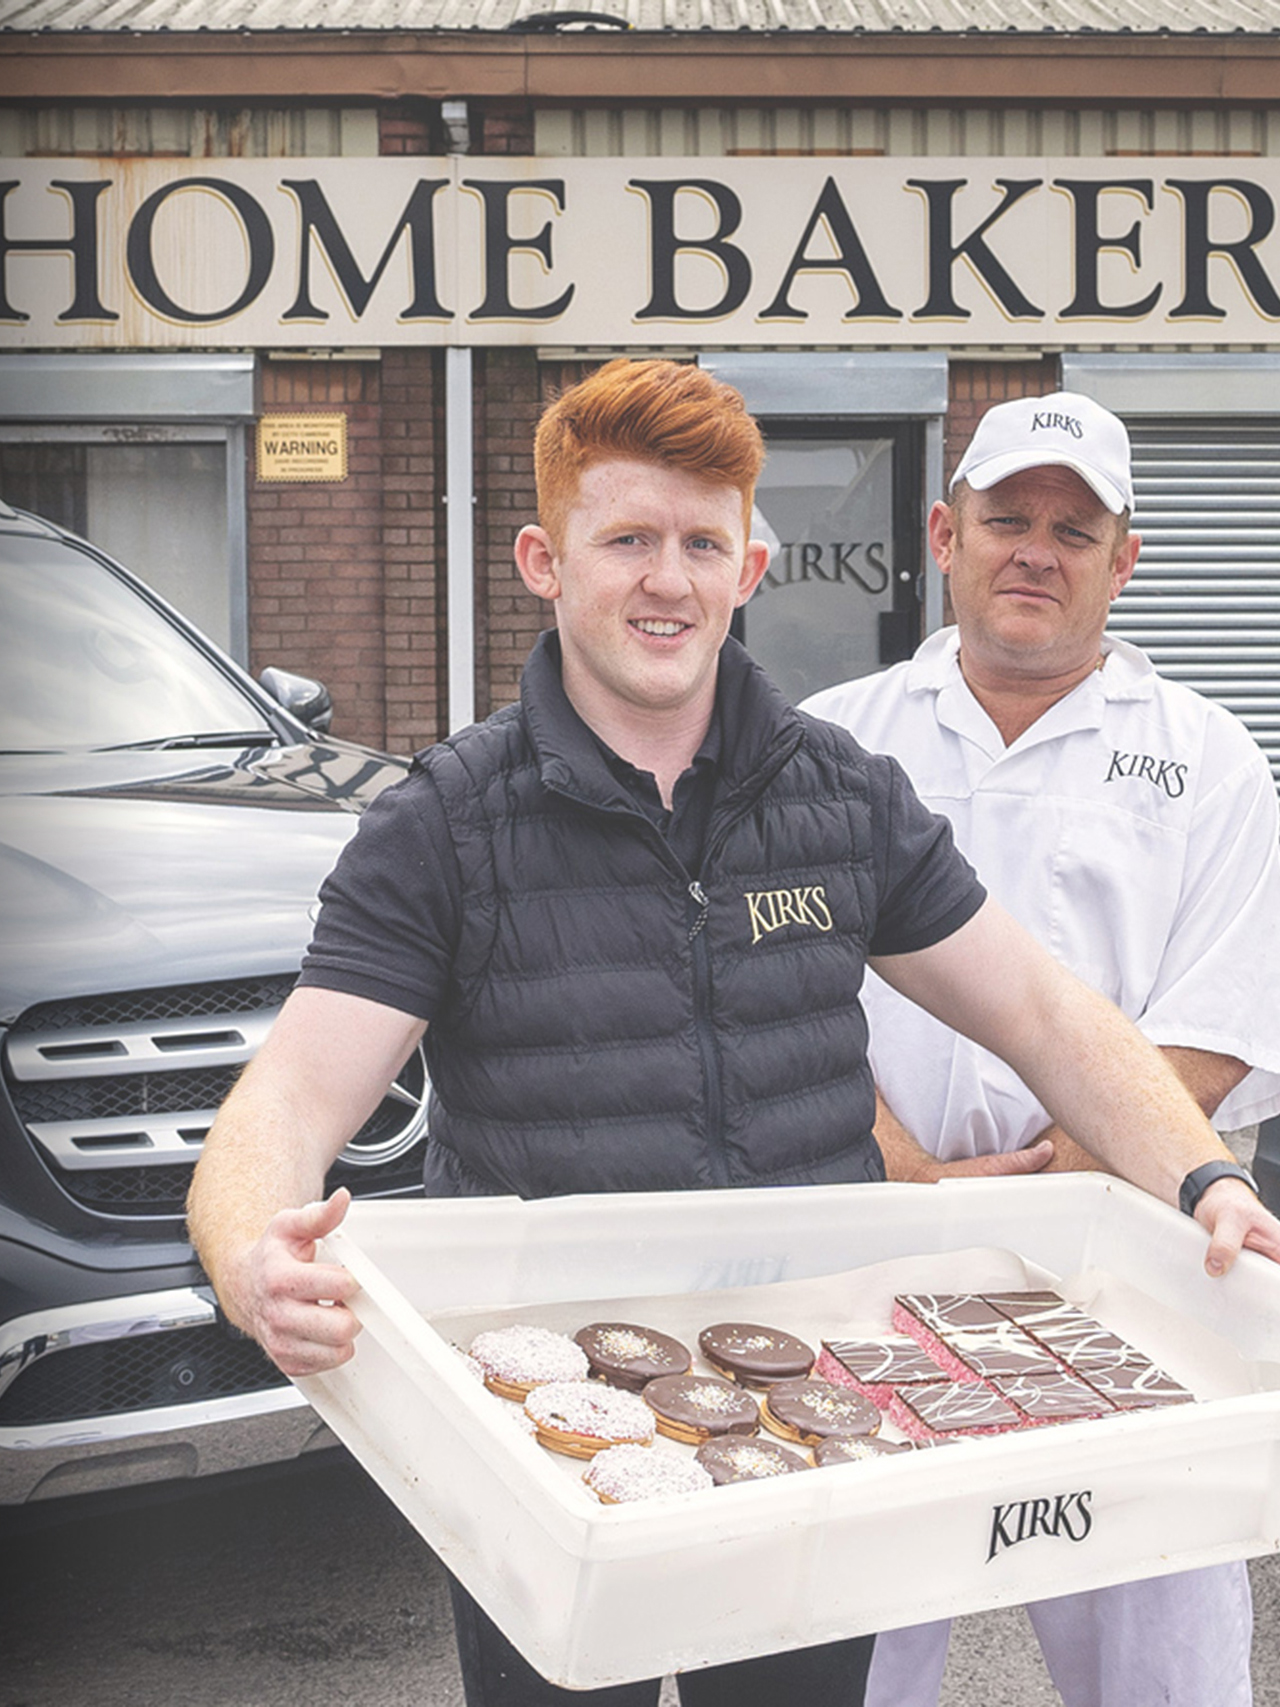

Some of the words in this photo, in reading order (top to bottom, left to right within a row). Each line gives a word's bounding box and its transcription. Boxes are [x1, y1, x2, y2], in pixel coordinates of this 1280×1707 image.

[264, 440, 338, 455] WARNING
[1030, 411, 1083, 439] KIRKS
[1103, 750, 1189, 798] KIRKS
[744, 886, 833, 944] KIRKS
[985, 1489, 1093, 1564] KIRKS
